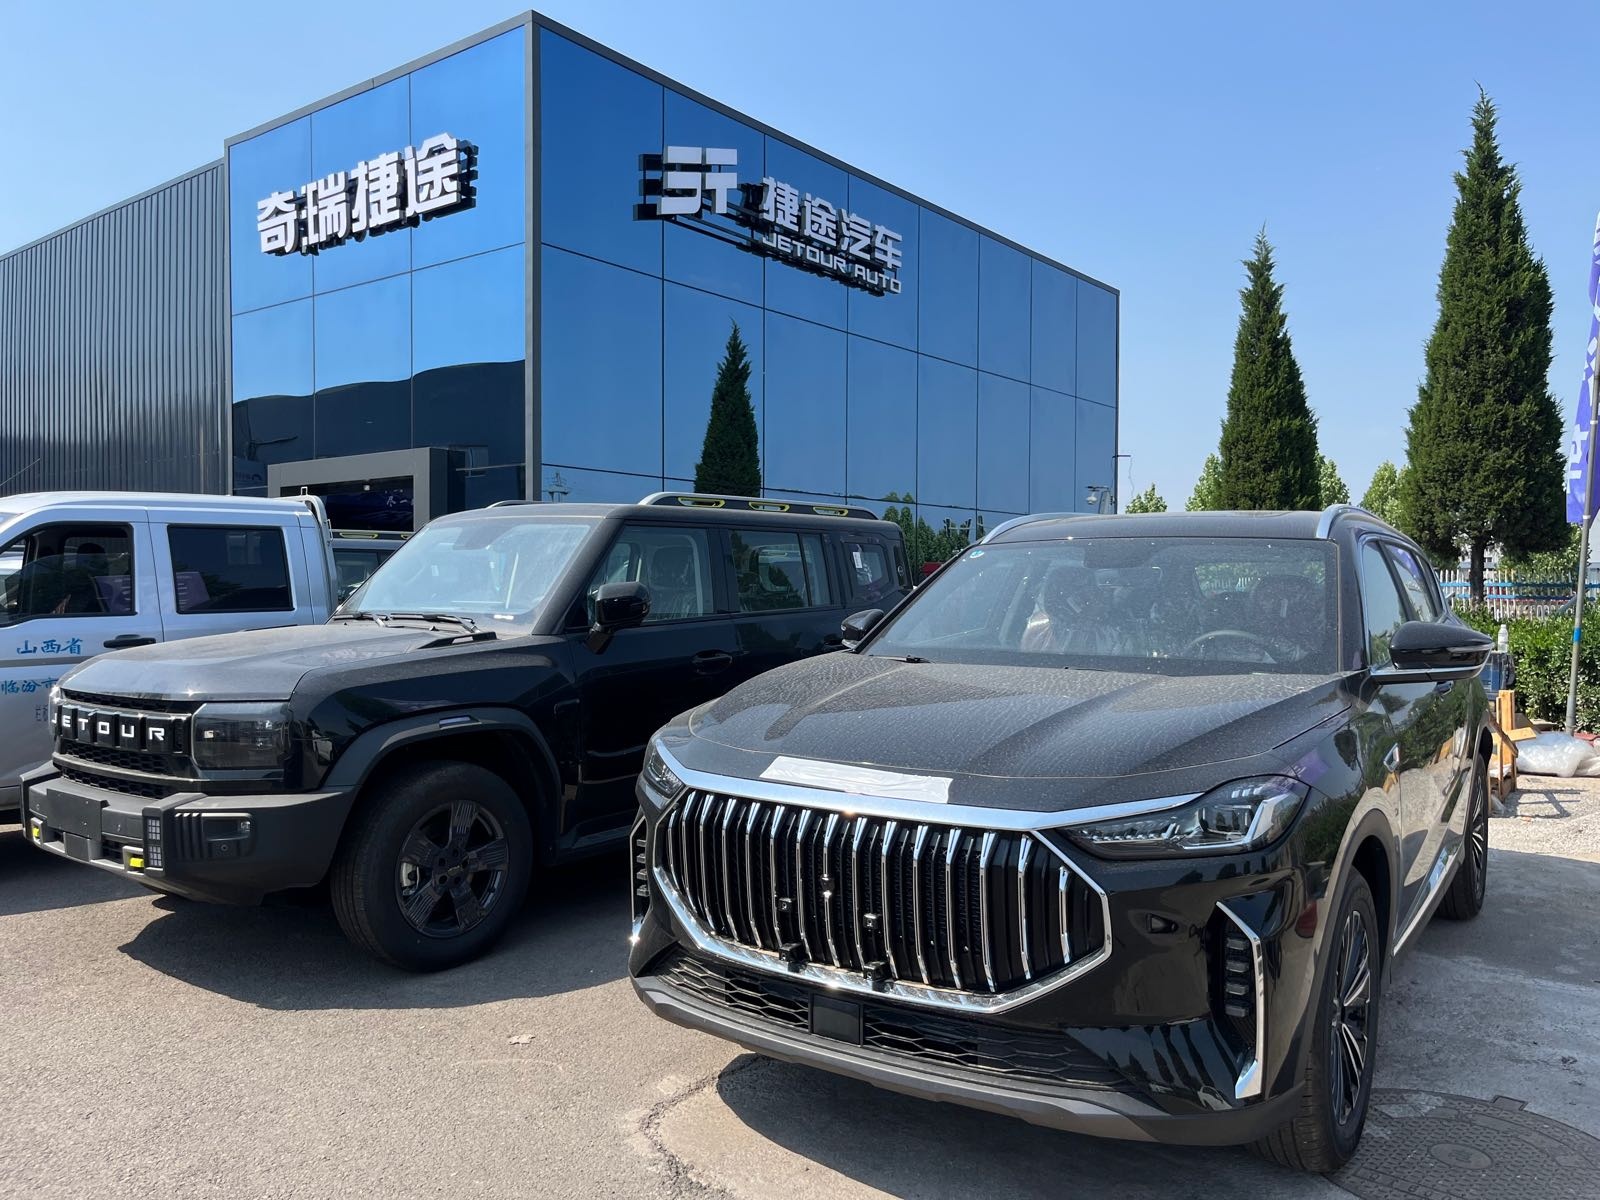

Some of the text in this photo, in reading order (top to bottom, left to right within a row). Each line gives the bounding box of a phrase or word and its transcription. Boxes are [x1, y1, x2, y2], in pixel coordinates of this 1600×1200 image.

[257, 132, 460, 253] 奇瑞捷途
[761, 176, 903, 269] 捷途汽车
[761, 231, 902, 294] JETOUR AUTO
[16, 637, 83, 655] 山西省
[51, 712, 165, 742] JETOUR
